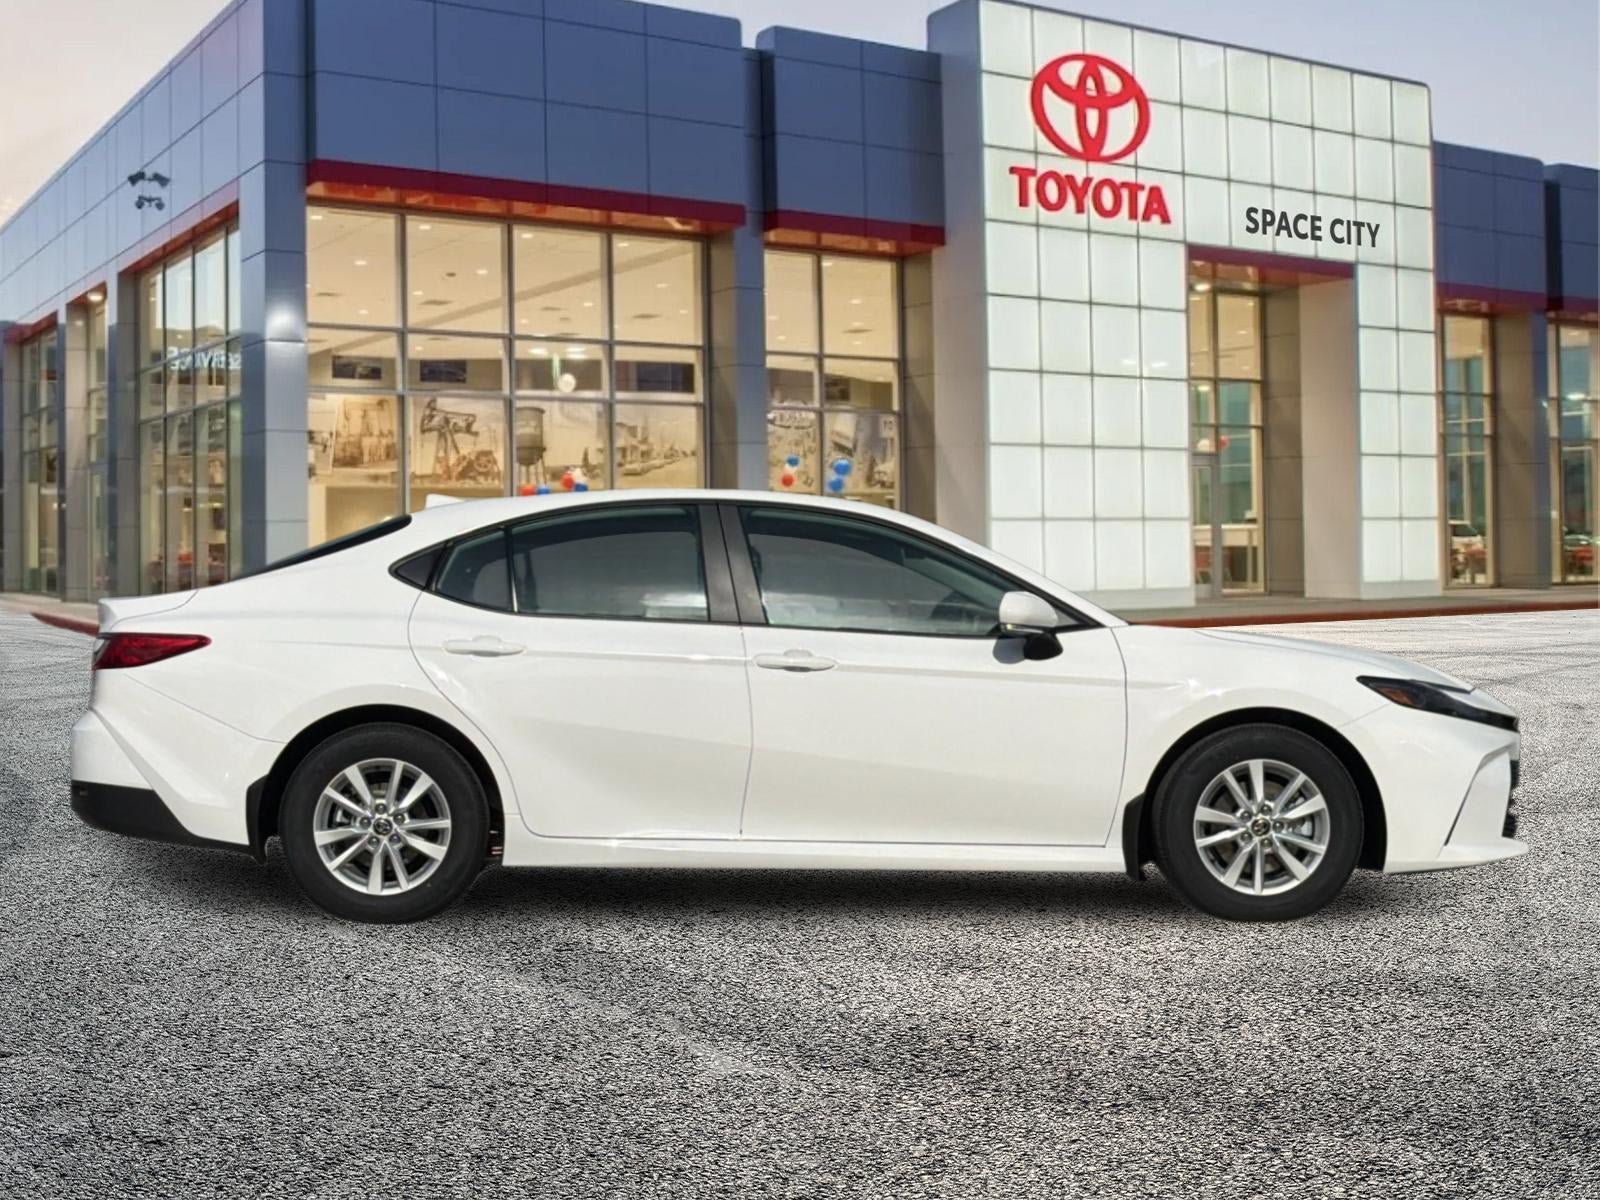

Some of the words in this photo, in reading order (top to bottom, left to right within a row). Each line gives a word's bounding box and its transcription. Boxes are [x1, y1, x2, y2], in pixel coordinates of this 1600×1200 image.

[1009, 166, 1171, 224] TOYOTA
[1245, 206, 1322, 241] SPACE
[1329, 218, 1380, 247] CITY
